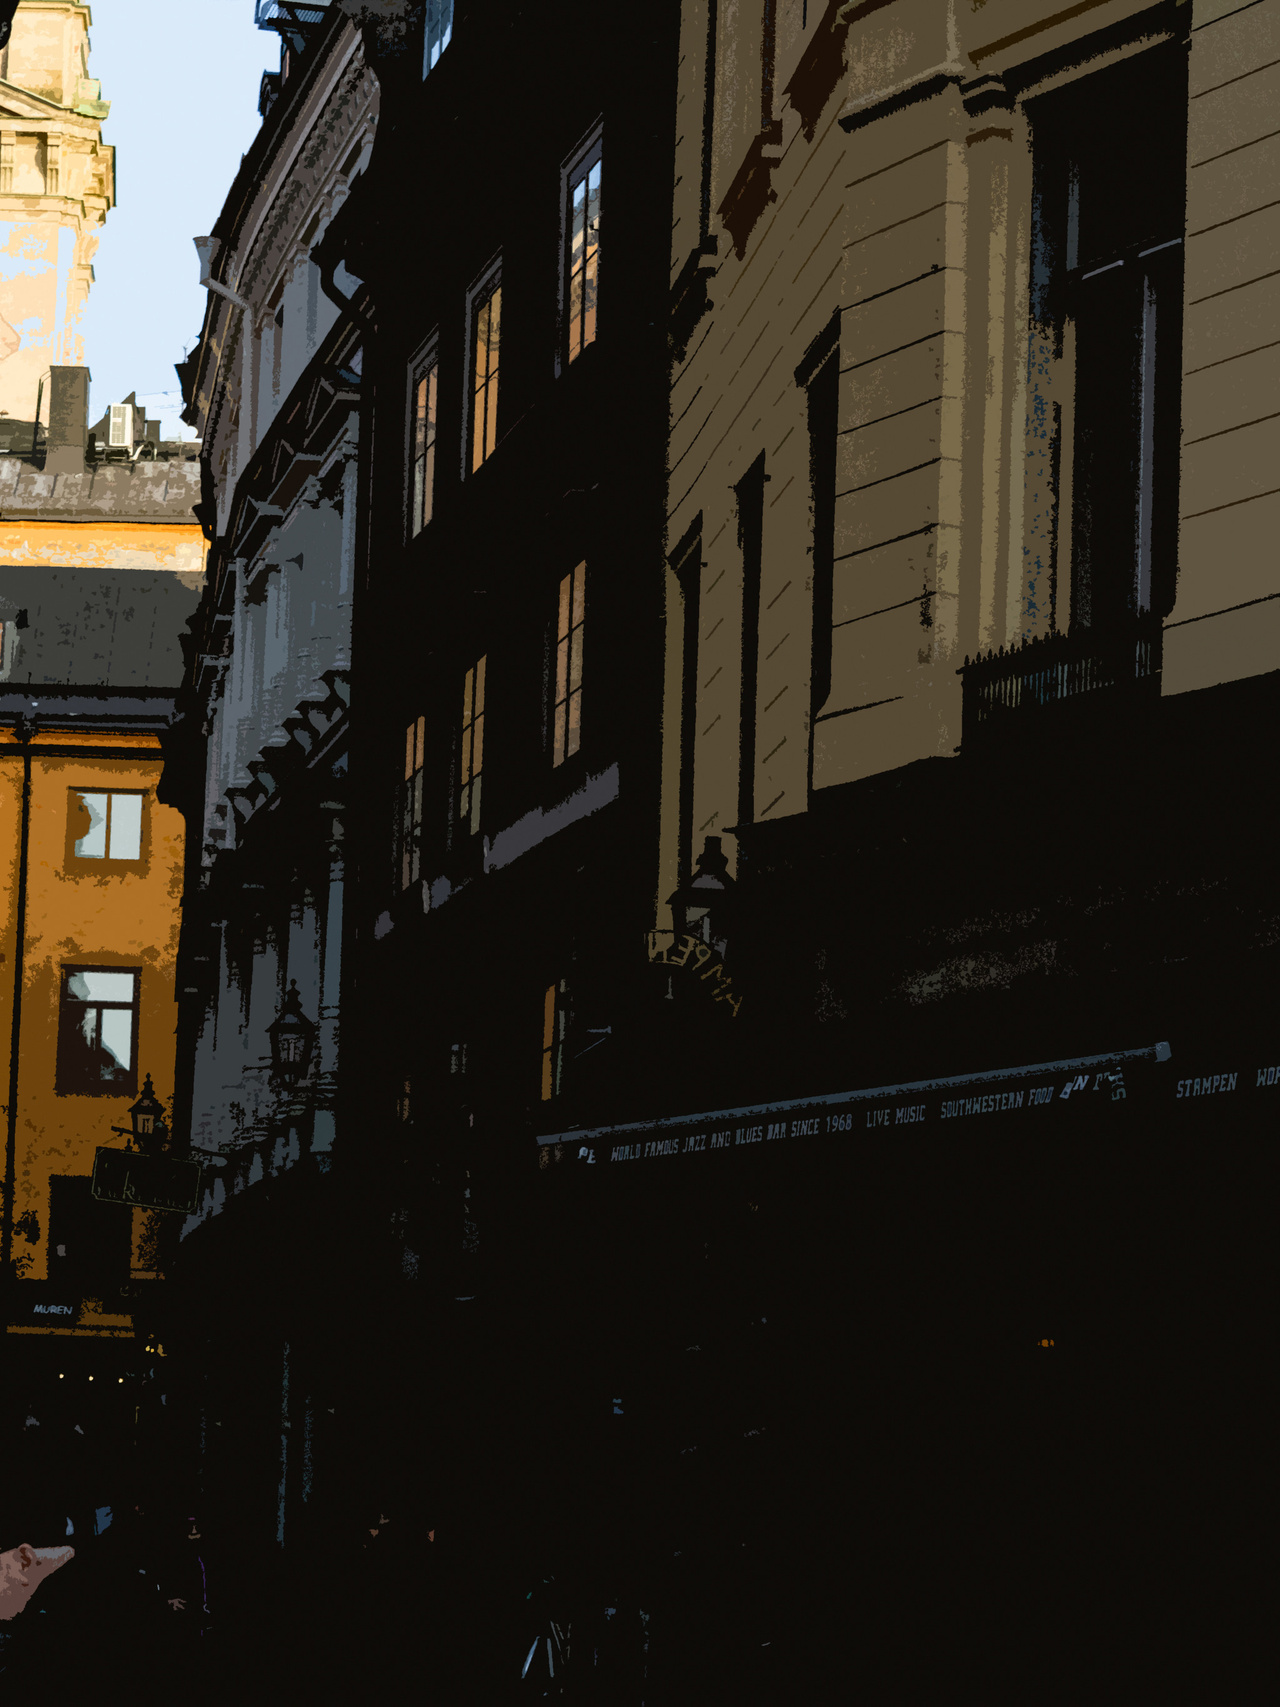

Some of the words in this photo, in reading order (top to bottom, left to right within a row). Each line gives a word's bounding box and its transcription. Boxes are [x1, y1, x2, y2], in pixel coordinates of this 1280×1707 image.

[1176, 1072, 1238, 1098] STAMPEN
[610, 1143, 641, 1162] WORLD
[643, 1138, 680, 1158] FAMOUS
[682, 1134, 707, 1153] JAZZ
[710, 1130, 731, 1149] AND
[735, 1125, 764, 1145] BLUES
[766, 1121, 787, 1141] BAR
[790, 1117, 820, 1138] SINCE
[826, 1113, 852, 1133] 1968
[866, 1108, 891, 1129] LIVE
[895, 1104, 926, 1125] MUSIC
[940, 1090, 1024, 1119] SOUTHWESTERN
[1028, 1086, 1055, 1107] FOOD
[32, 1304, 73, 1315] MUREN
